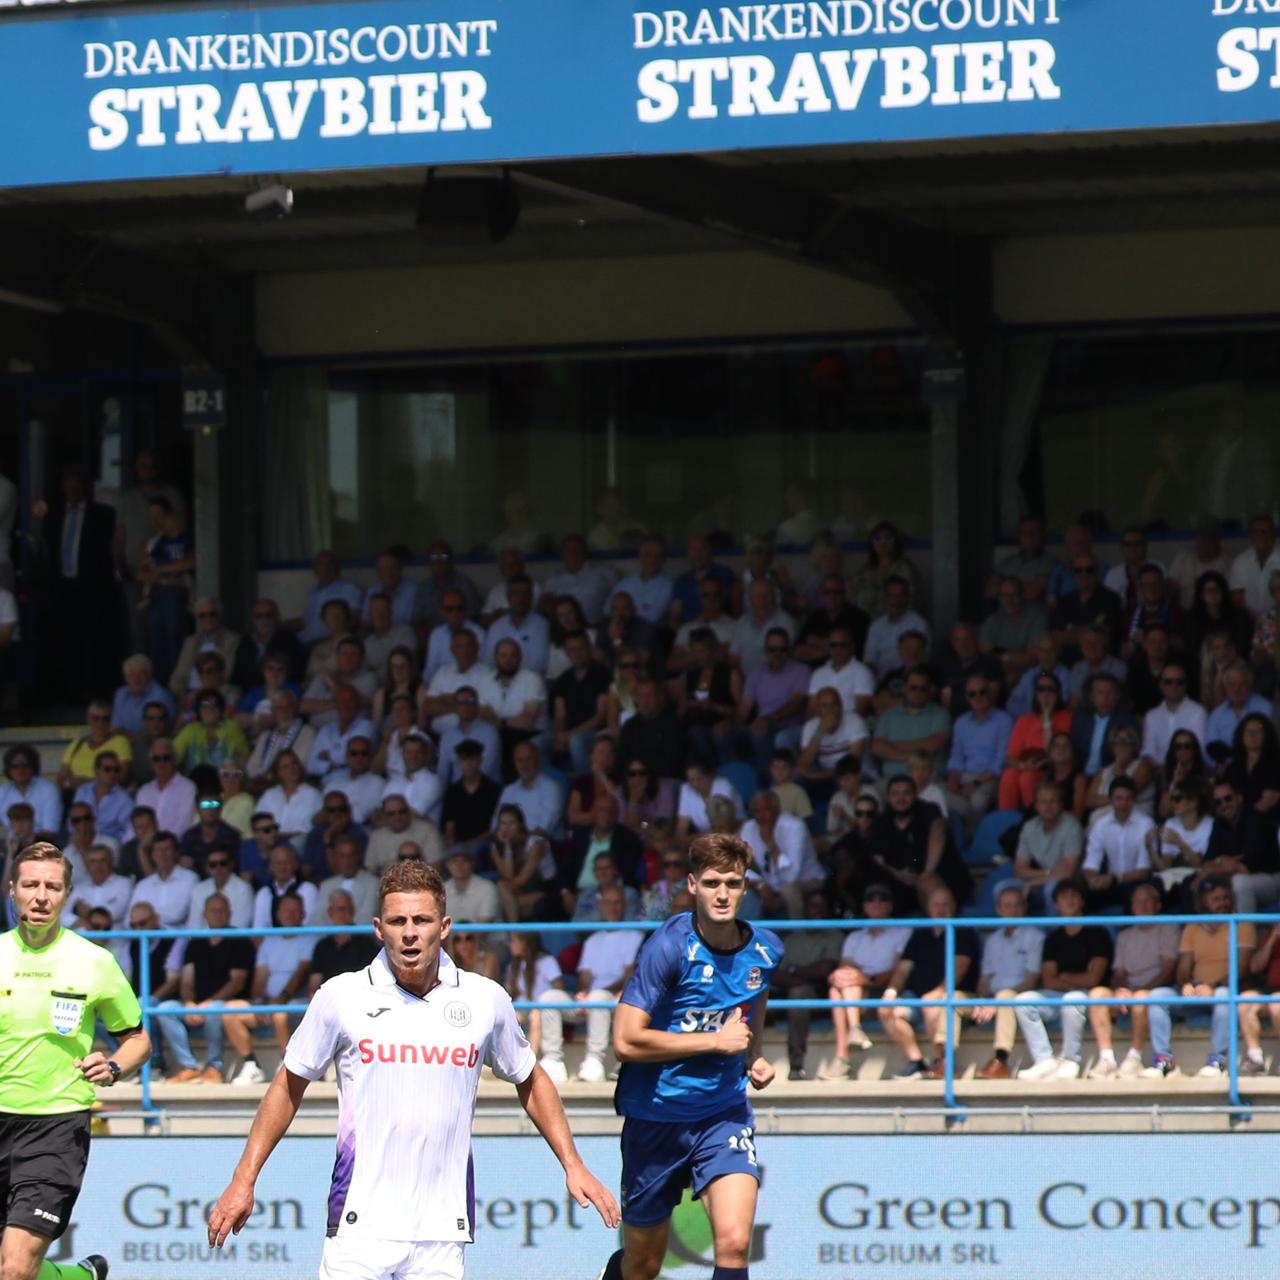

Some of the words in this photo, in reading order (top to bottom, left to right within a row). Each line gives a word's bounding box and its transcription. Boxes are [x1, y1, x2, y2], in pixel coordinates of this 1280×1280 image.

[84, 20, 497, 78] DRANKENDISCOUNT
[636, 38, 1061, 123] STRAVBIER
[88, 70, 492, 151] STRAVBIER
[183, 390, 223, 414] B2-1
[55, 1001, 79, 1012] FIFA
[681, 1009, 736, 1032] STA
[358, 1038, 479, 1069] Sunweb
[122, 1183, 306, 1230] Gren
[818, 1182, 1016, 1230] Green
[1038, 1182, 1280, 1248] Concep
[122, 1242, 237, 1262] BELGIUM
[247, 1242, 290, 1262] SRL
[819, 1243, 941, 1264] BELGIUM
[952, 1243, 999, 1264] SRL
